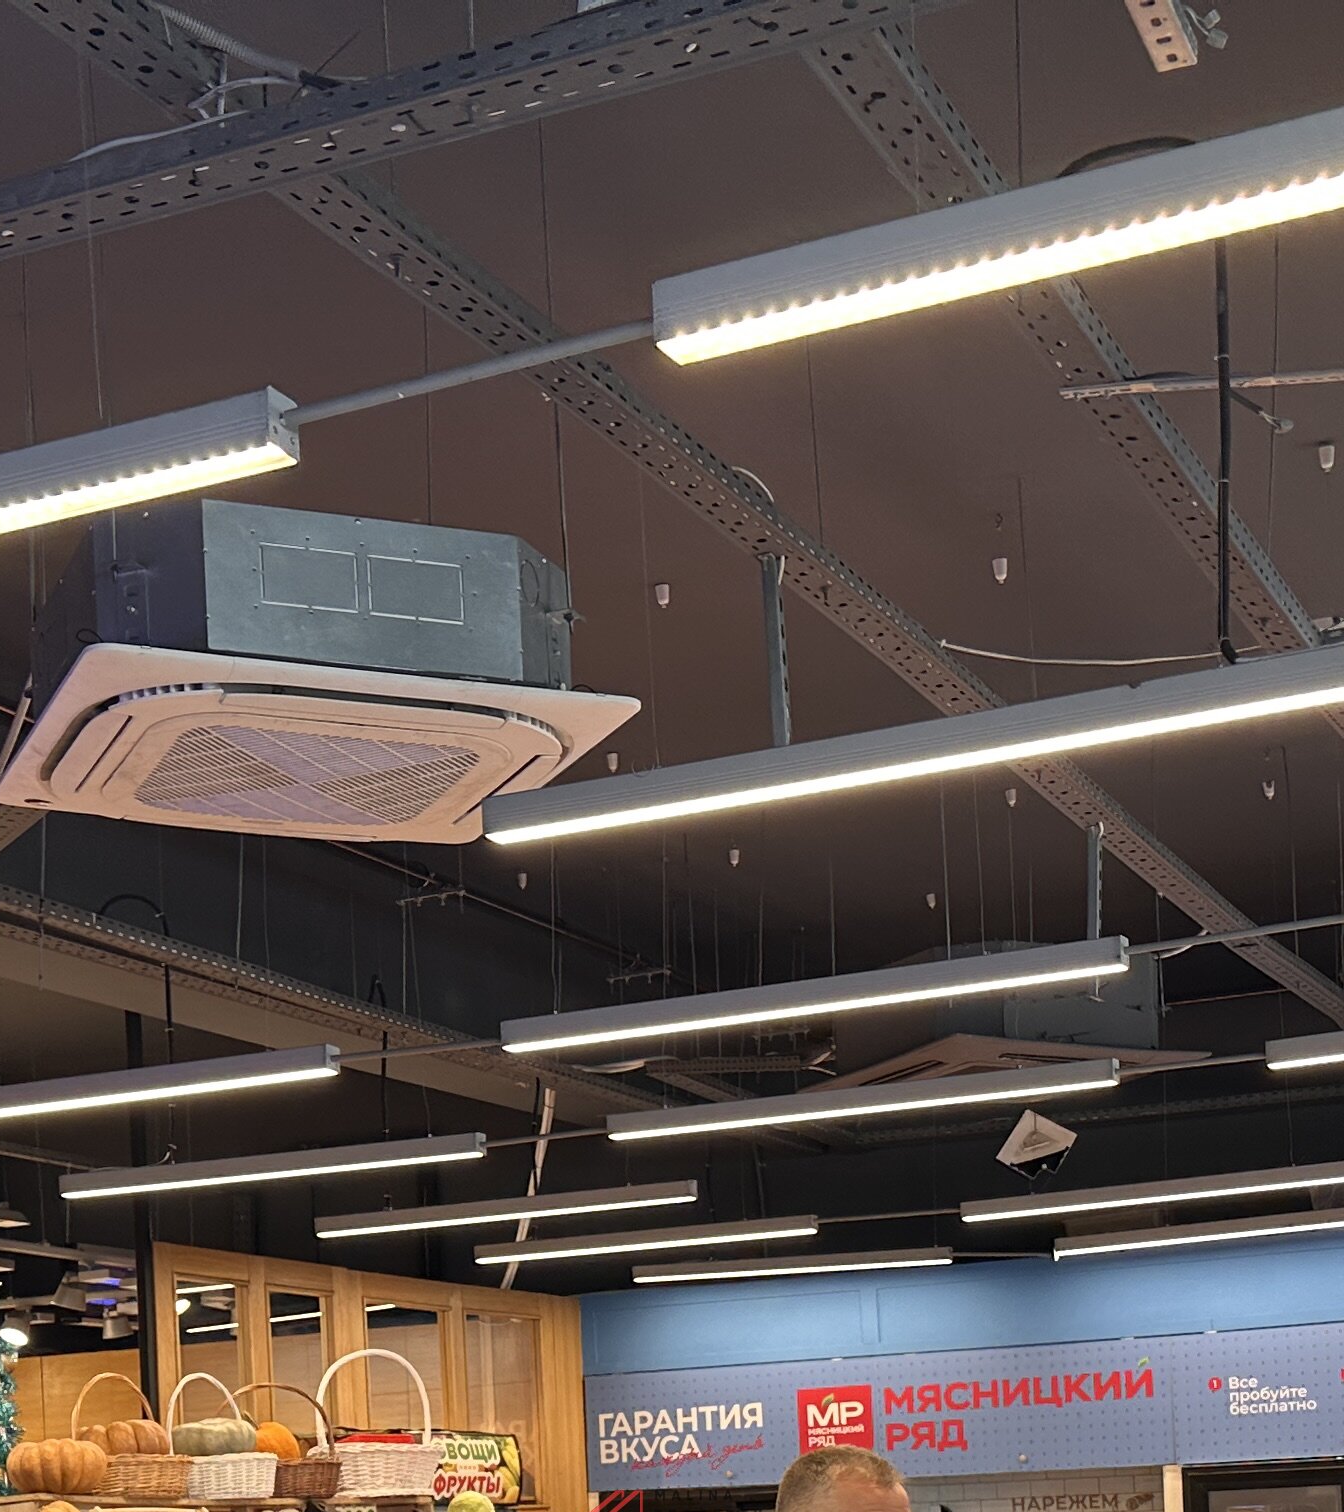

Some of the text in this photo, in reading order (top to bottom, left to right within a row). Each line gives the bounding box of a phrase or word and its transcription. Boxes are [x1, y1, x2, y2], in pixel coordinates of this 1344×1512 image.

[883, 1368, 1154, 1415] МЯСНИЦКИЙ
[1228, 1377, 1258, 1390] Все
[1229, 1385, 1308, 1403] пробуйте
[1229, 1398, 1318, 1416] бесплатно
[598, 1402, 764, 1438] ГАРАНТИЯ
[808, 1425, 865, 1436] МЯСНИЦКИЙ
[885, 1418, 968, 1452] РЯД
[600, 1433, 703, 1465] ВКУСА
[808, 1436, 836, 1448] РЯД
[434, 1473, 502, 1498] ФРУКТЫ
[1011, 1494, 1119, 1512] НАРЕЖЕМ
